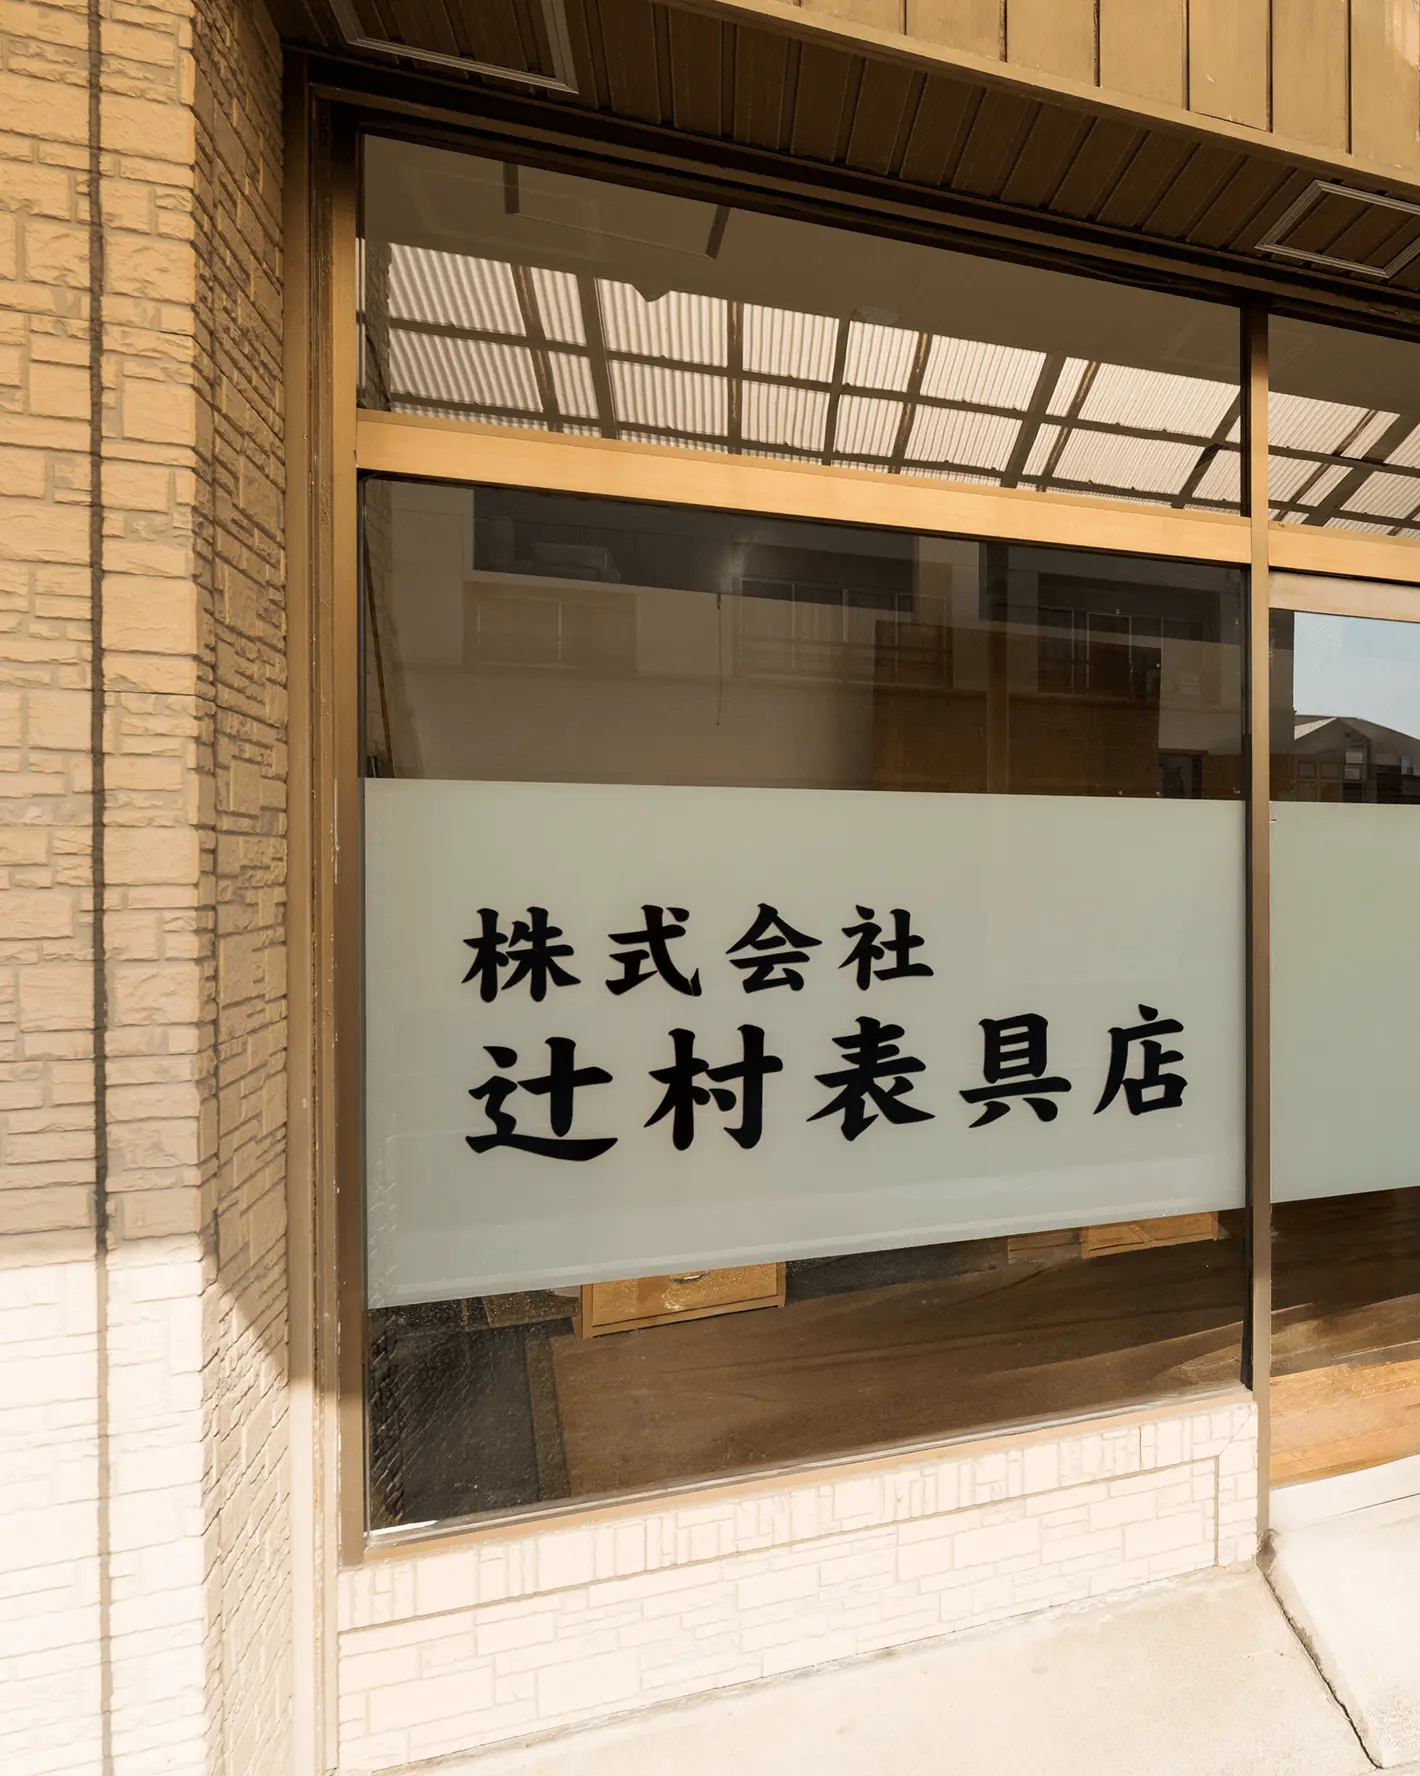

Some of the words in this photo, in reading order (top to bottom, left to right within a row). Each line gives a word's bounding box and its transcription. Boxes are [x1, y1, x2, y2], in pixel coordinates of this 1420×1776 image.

[462, 903, 935, 1002] 株式会社
[466, 1004, 1187, 1161] 辻村表具店
